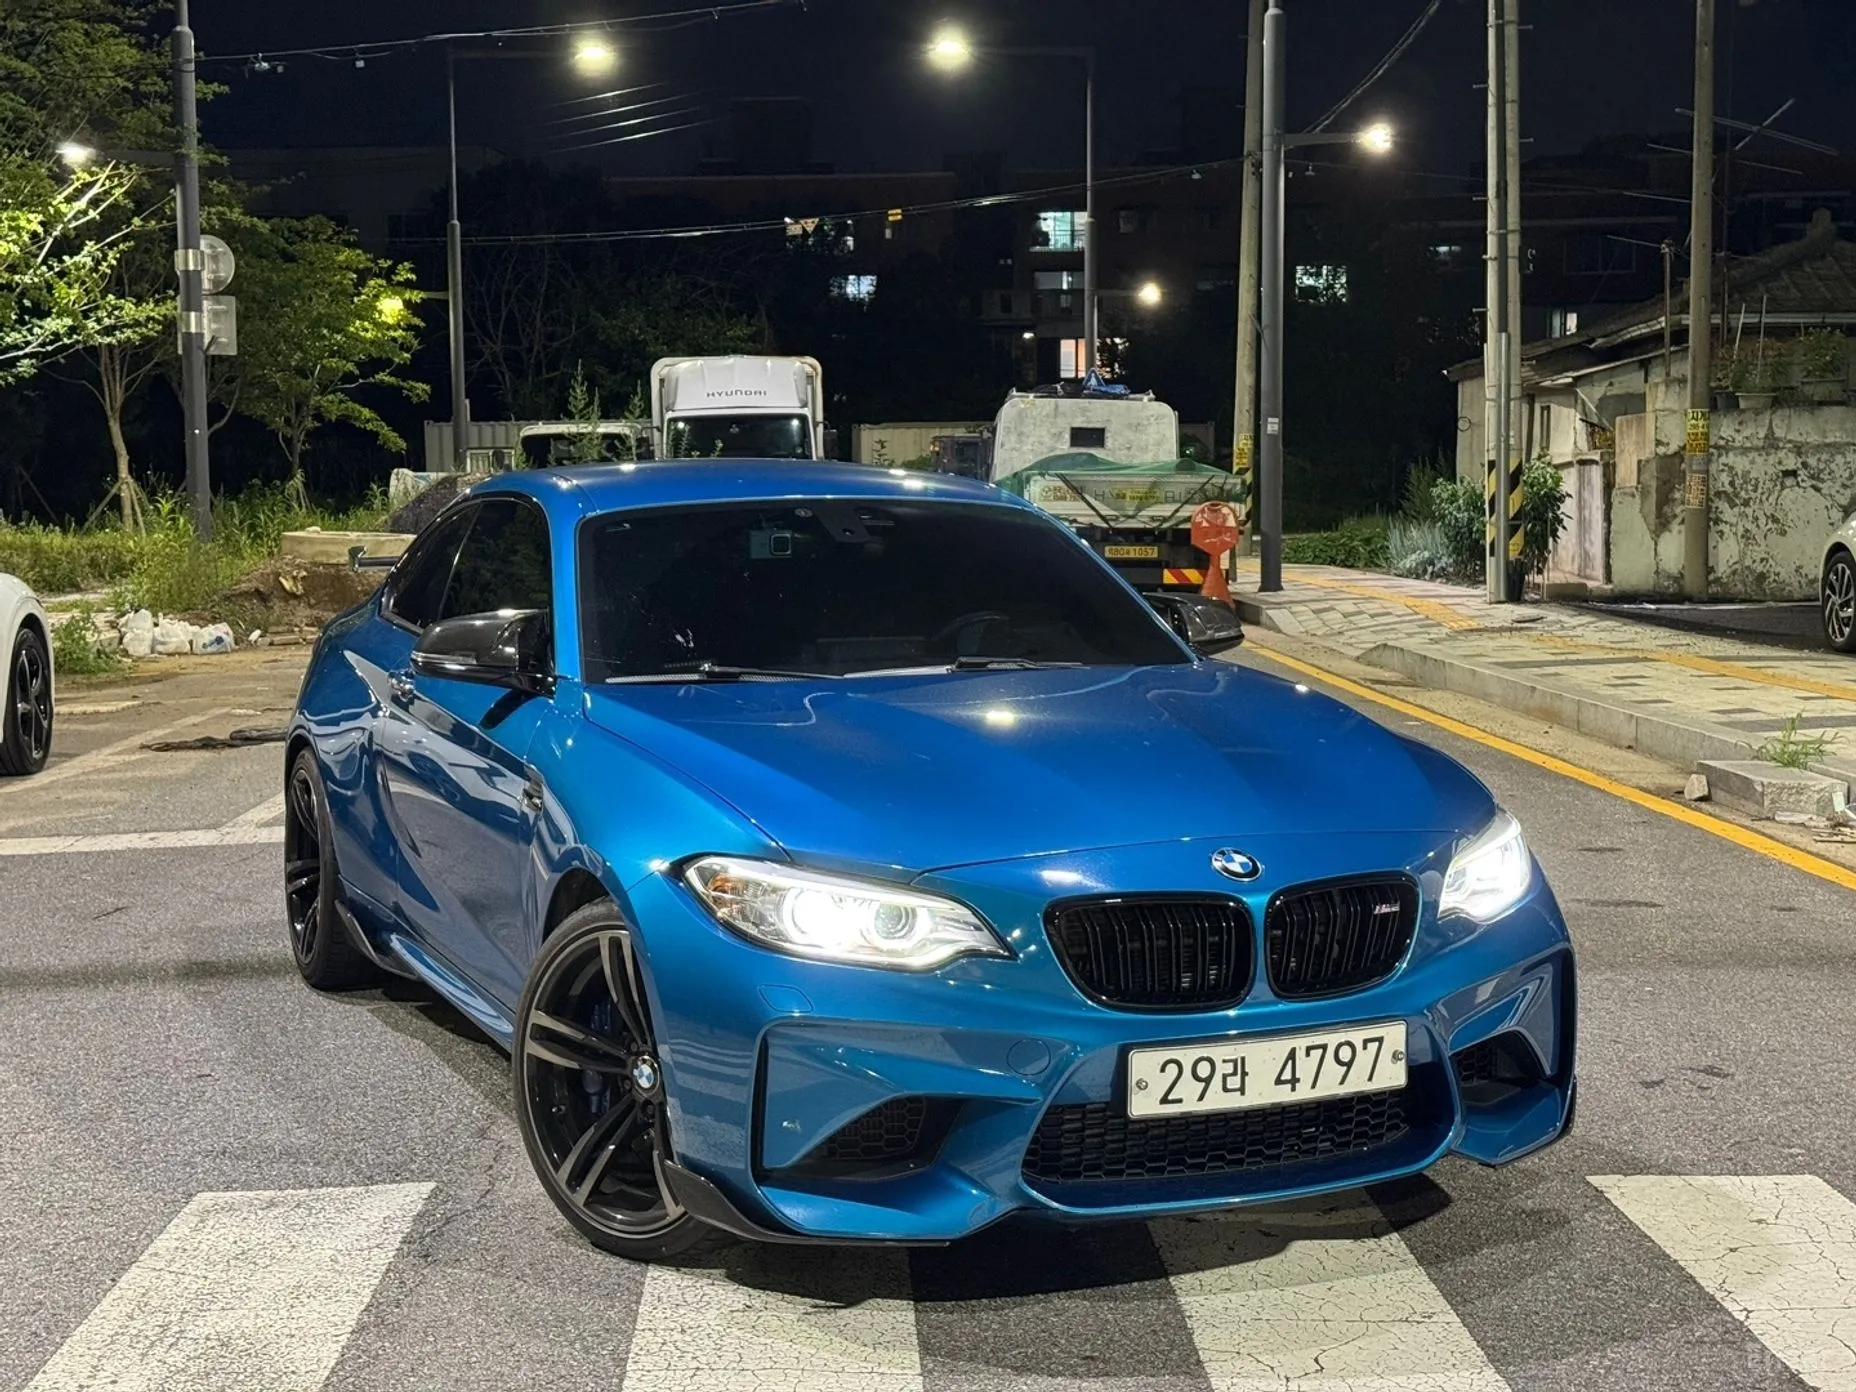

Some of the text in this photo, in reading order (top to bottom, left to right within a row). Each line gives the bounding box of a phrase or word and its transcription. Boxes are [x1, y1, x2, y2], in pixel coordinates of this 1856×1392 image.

[706, 389, 767, 398] HYUNDAI
[1133, 547, 1155, 557] 1057
[1158, 1036, 1385, 1105] 29라 4797
